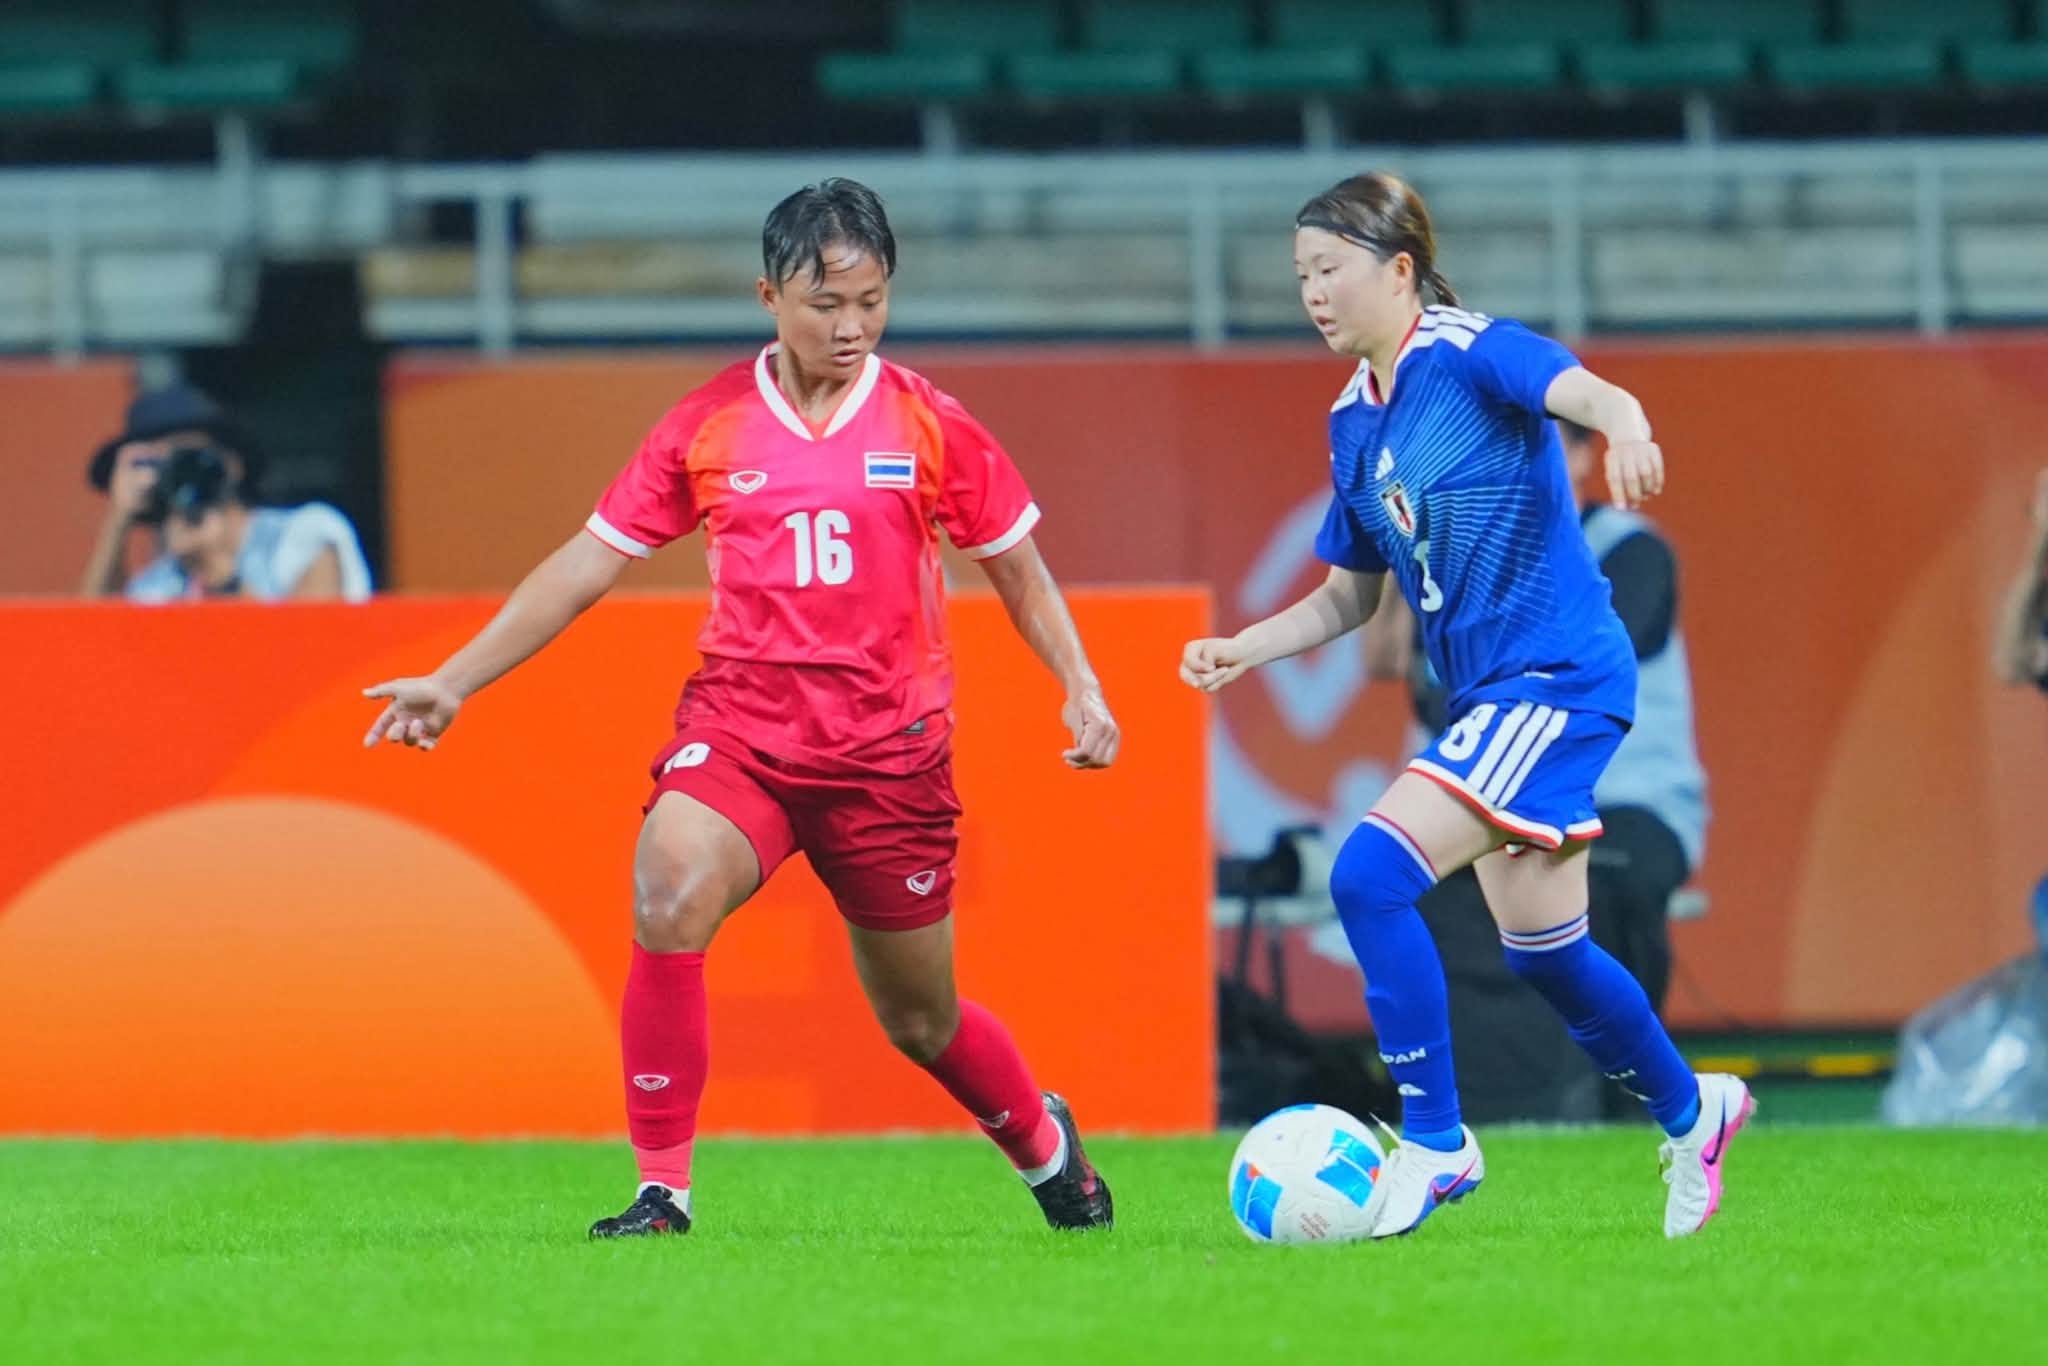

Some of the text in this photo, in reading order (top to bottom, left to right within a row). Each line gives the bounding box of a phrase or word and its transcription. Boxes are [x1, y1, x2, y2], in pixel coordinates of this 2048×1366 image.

[784, 509, 853, 587] 16
[1438, 703, 1499, 761] 8
[1379, 1047, 1426, 1064] PAN
